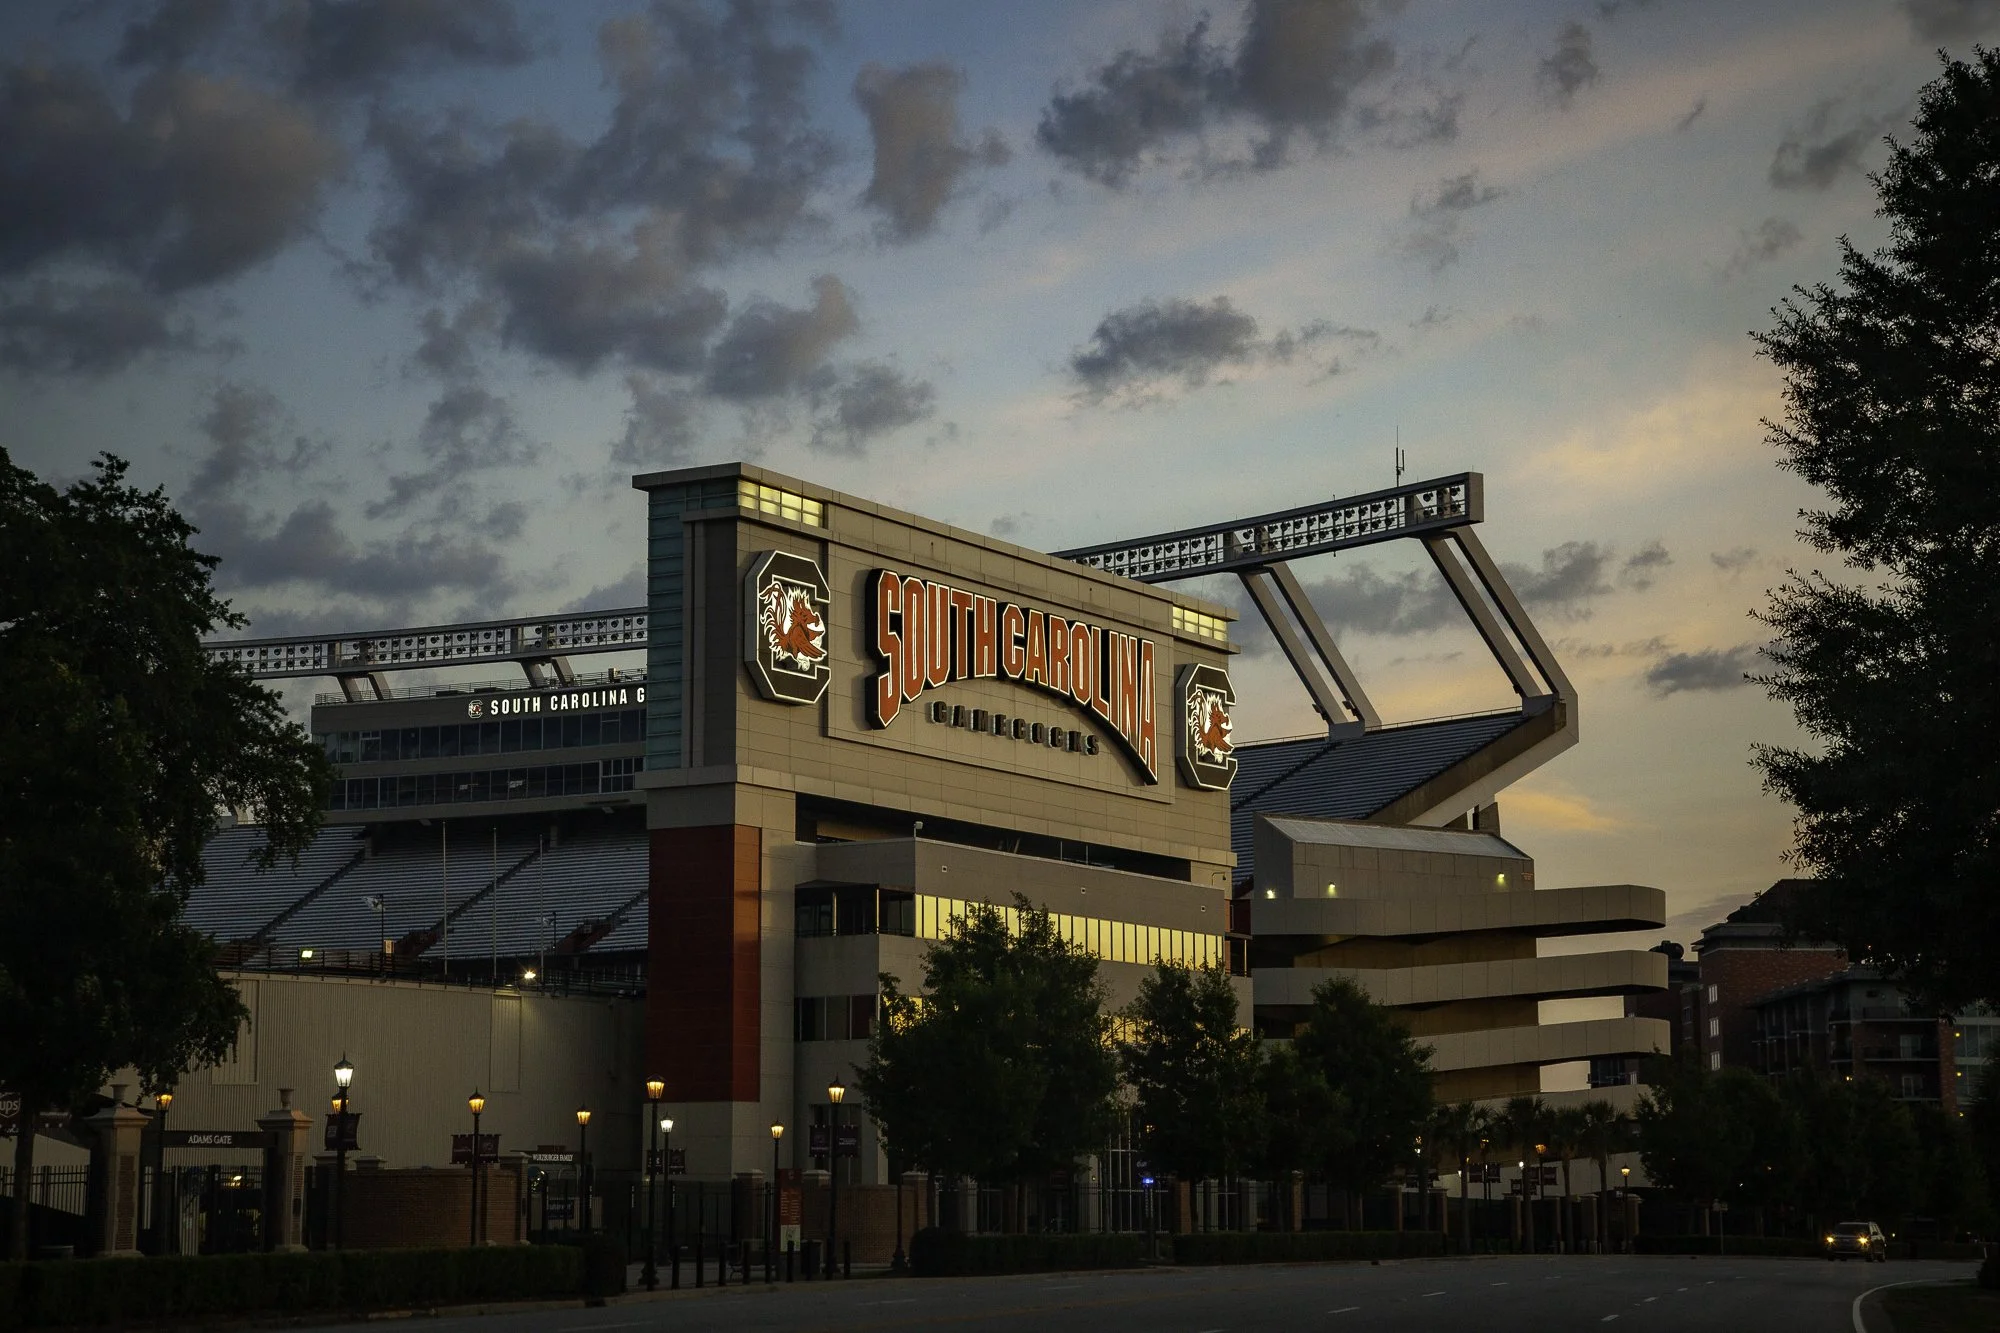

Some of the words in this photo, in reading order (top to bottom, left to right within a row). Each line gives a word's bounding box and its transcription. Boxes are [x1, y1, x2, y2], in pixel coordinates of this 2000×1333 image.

[873, 567, 998, 730] SOUTH
[1000, 602, 1158, 784] CAROLINA
[490, 695, 542, 716] SOUTH
[550, 688, 628, 711] CAROLINA
[931, 700, 1100, 756] GAMECOCKS
[0, 1100, 19, 1115] ups
[187, 1134, 213, 1145] ADAMS
[213, 1134, 233, 1145] GATE
